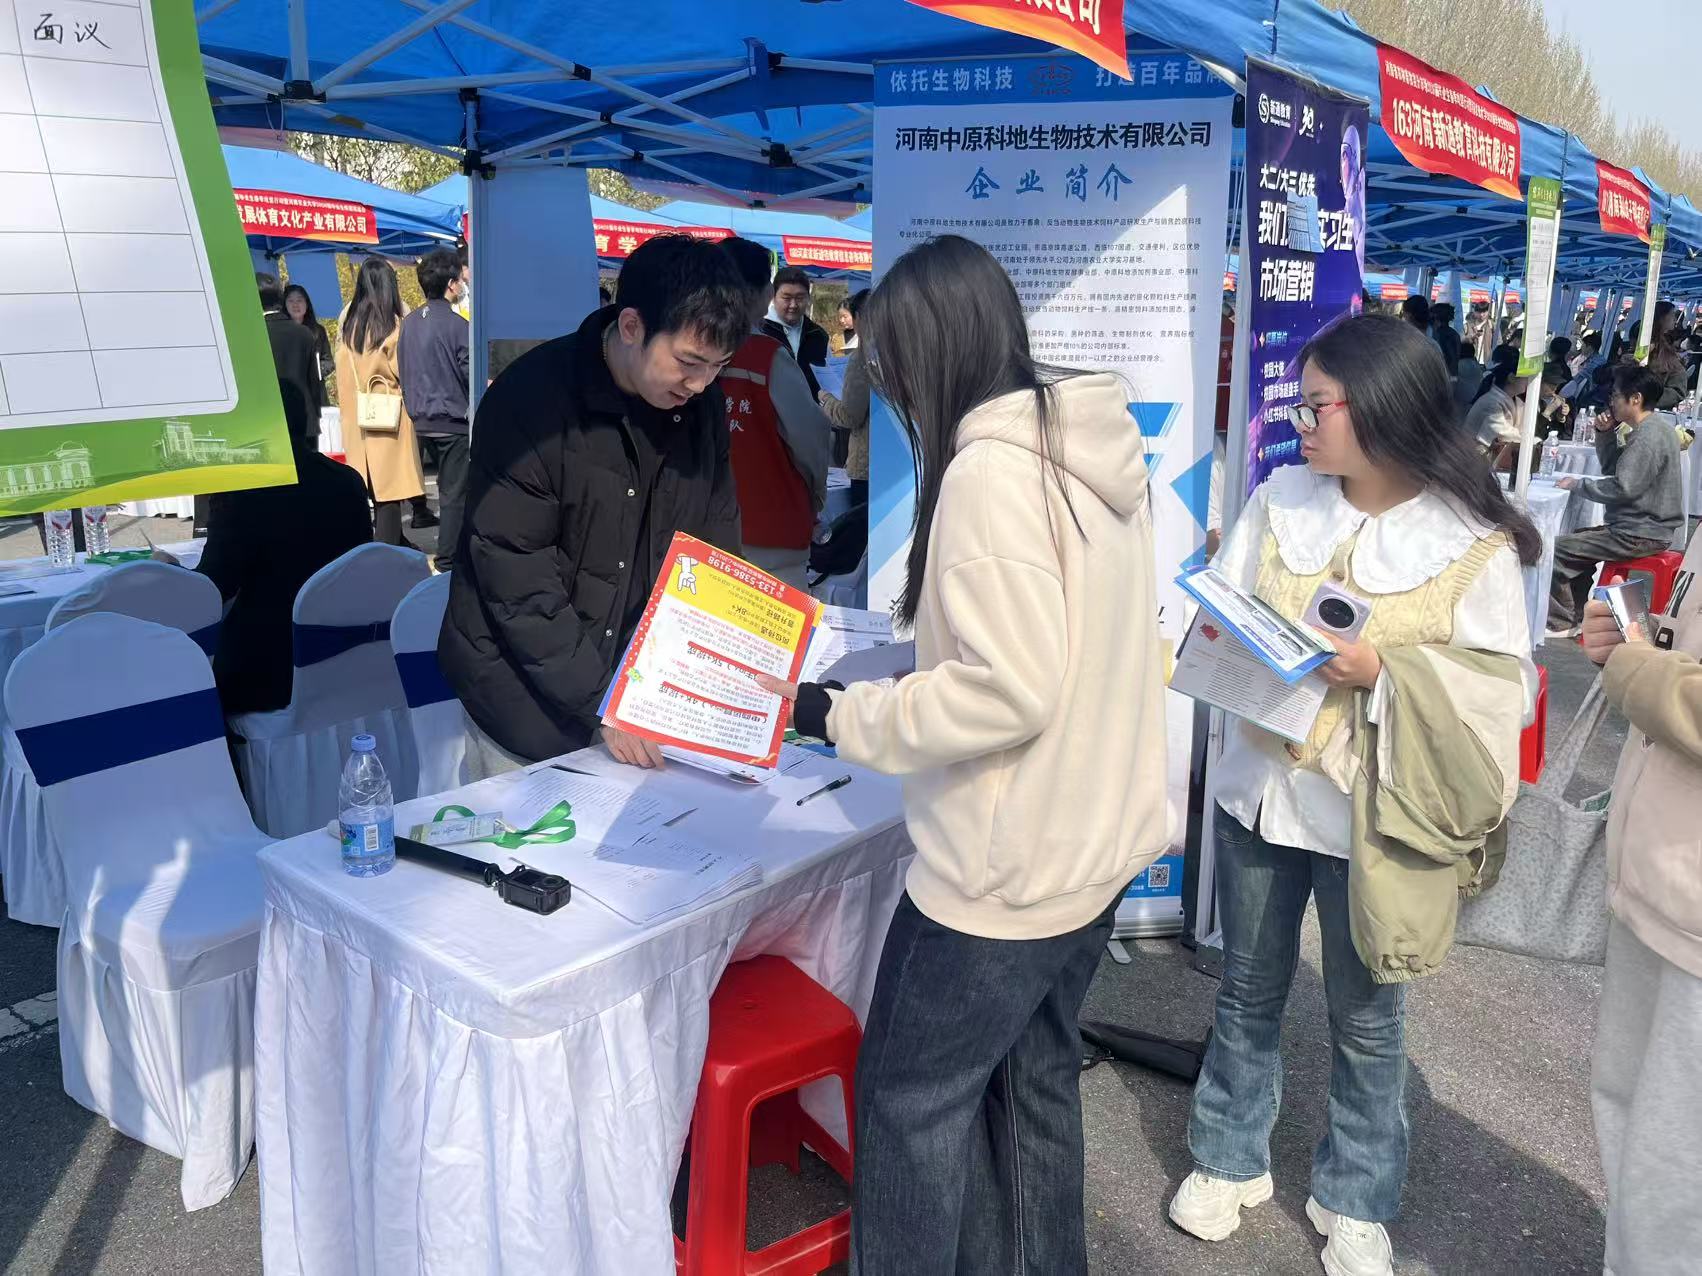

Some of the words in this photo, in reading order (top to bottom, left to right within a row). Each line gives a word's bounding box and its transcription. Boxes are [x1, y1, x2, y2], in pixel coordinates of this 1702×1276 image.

[34, 13, 112, 49] 面议
[889, 66, 1014, 93] 依托生物科技
[895, 121, 1212, 152] 河南中原科地生物技术有限公司
[1392, 97, 1516, 182] 163河南新通教育科技有限公司
[965, 162, 1134, 202] 企业简介
[1258, 261, 1315, 303] 市场营销
[707, 556, 776, 596] 133-5386-9198
